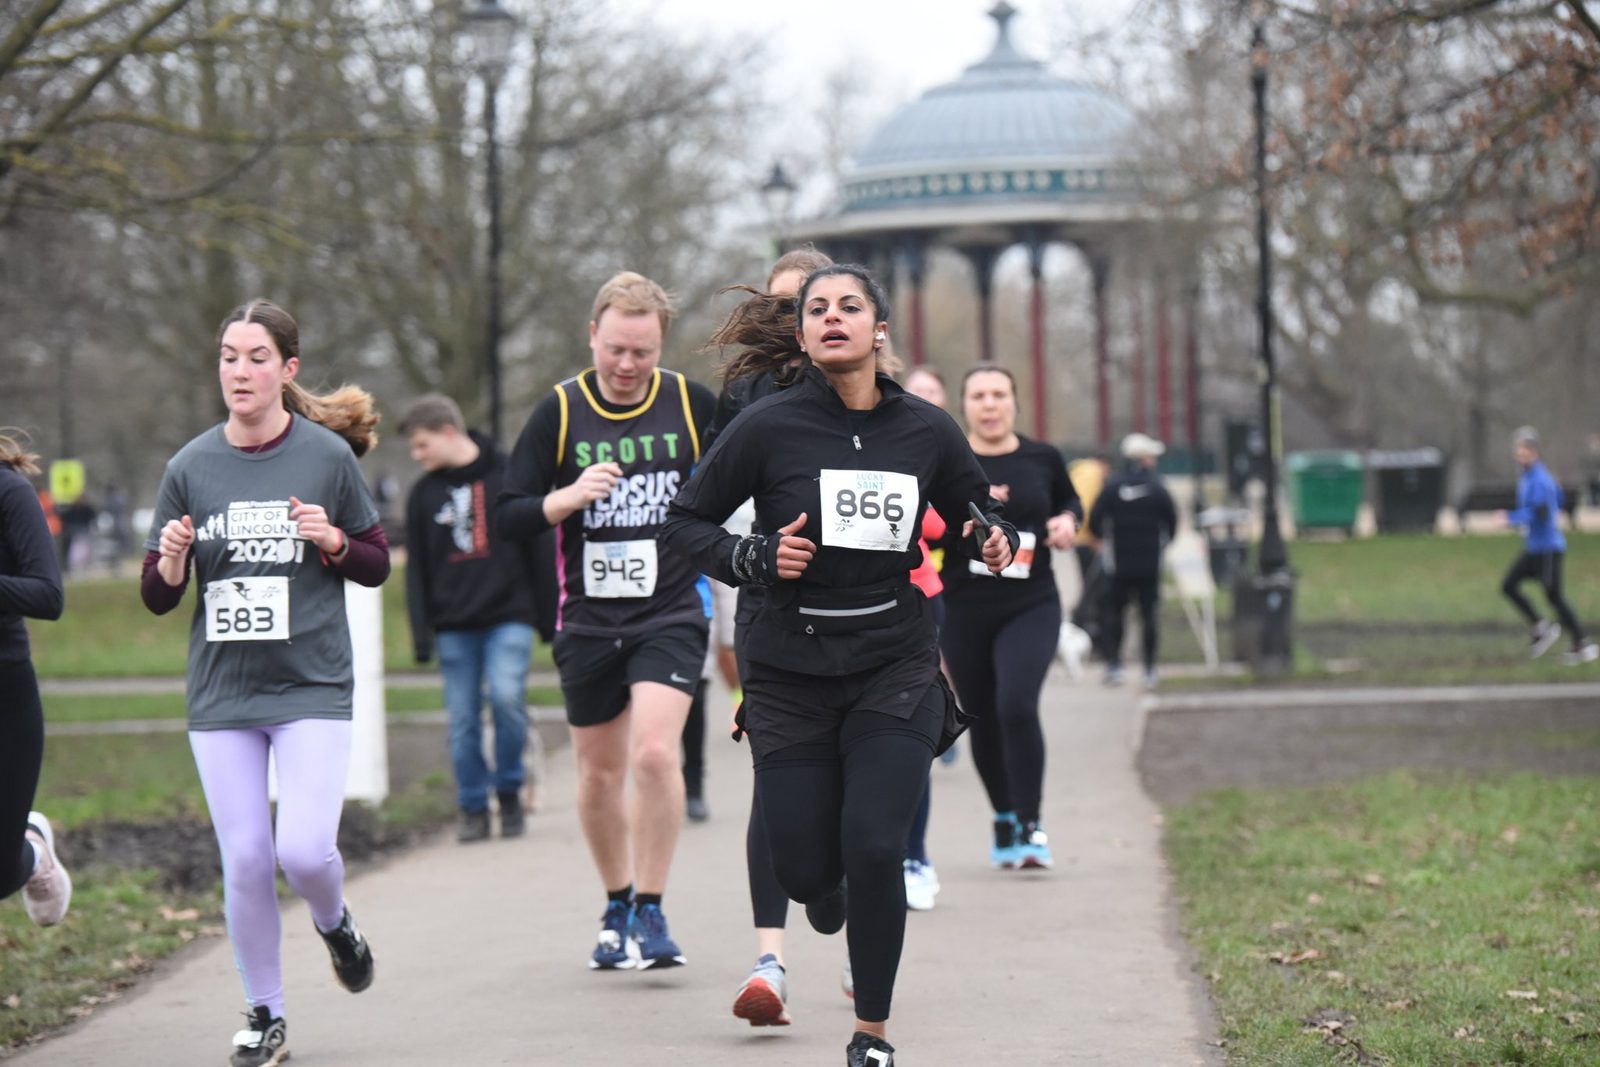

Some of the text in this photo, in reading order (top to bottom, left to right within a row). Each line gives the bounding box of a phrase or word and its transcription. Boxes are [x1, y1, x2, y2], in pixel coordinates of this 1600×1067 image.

[575, 433, 678, 468] SCOTT
[857, 481, 885, 490] SAINT
[231, 511, 282, 522] CITY OF
[835, 489, 905, 523] 866
[231, 524, 291, 535] LINCOLN
[591, 558, 646, 582] 942
[216, 606, 274, 634] 583
